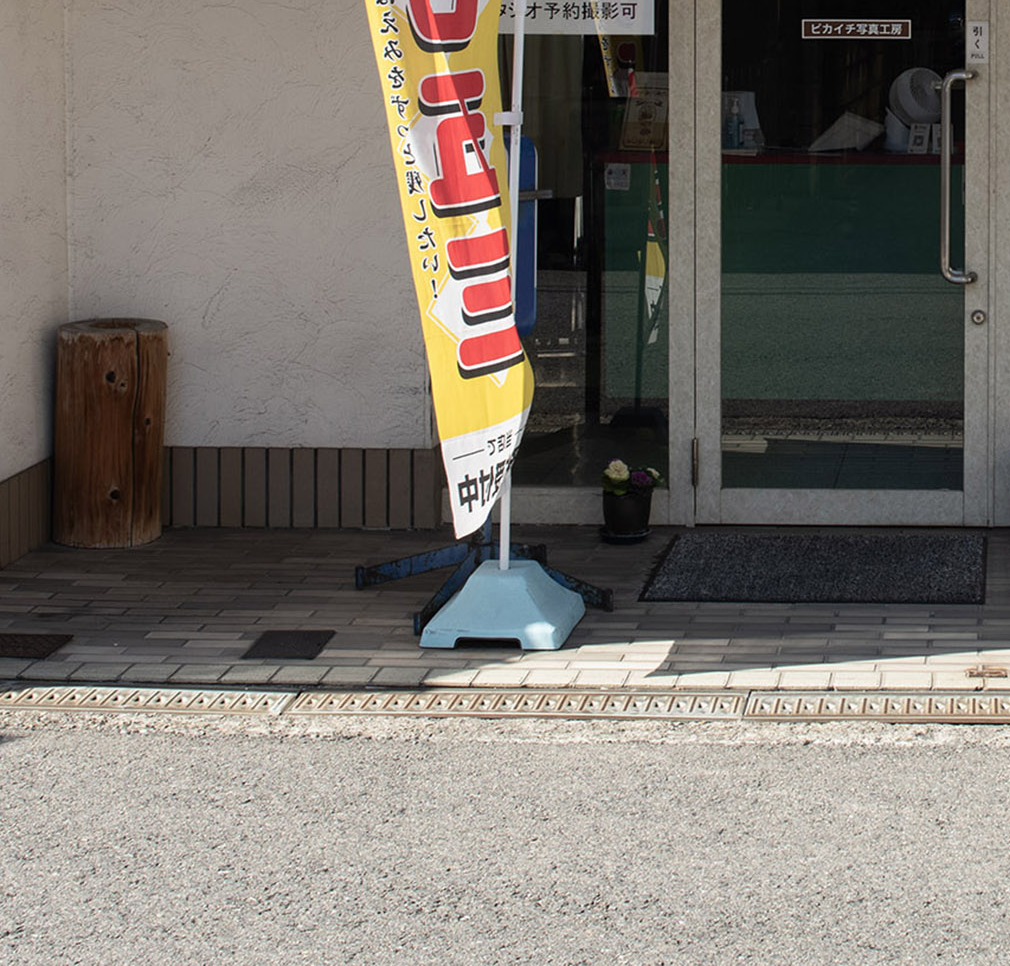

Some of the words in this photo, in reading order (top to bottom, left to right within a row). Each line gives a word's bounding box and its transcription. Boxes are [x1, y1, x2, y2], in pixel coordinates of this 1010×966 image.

[810, 23, 903, 35] ピカイチ写真工房
[972, 26, 983, 50] 引く
